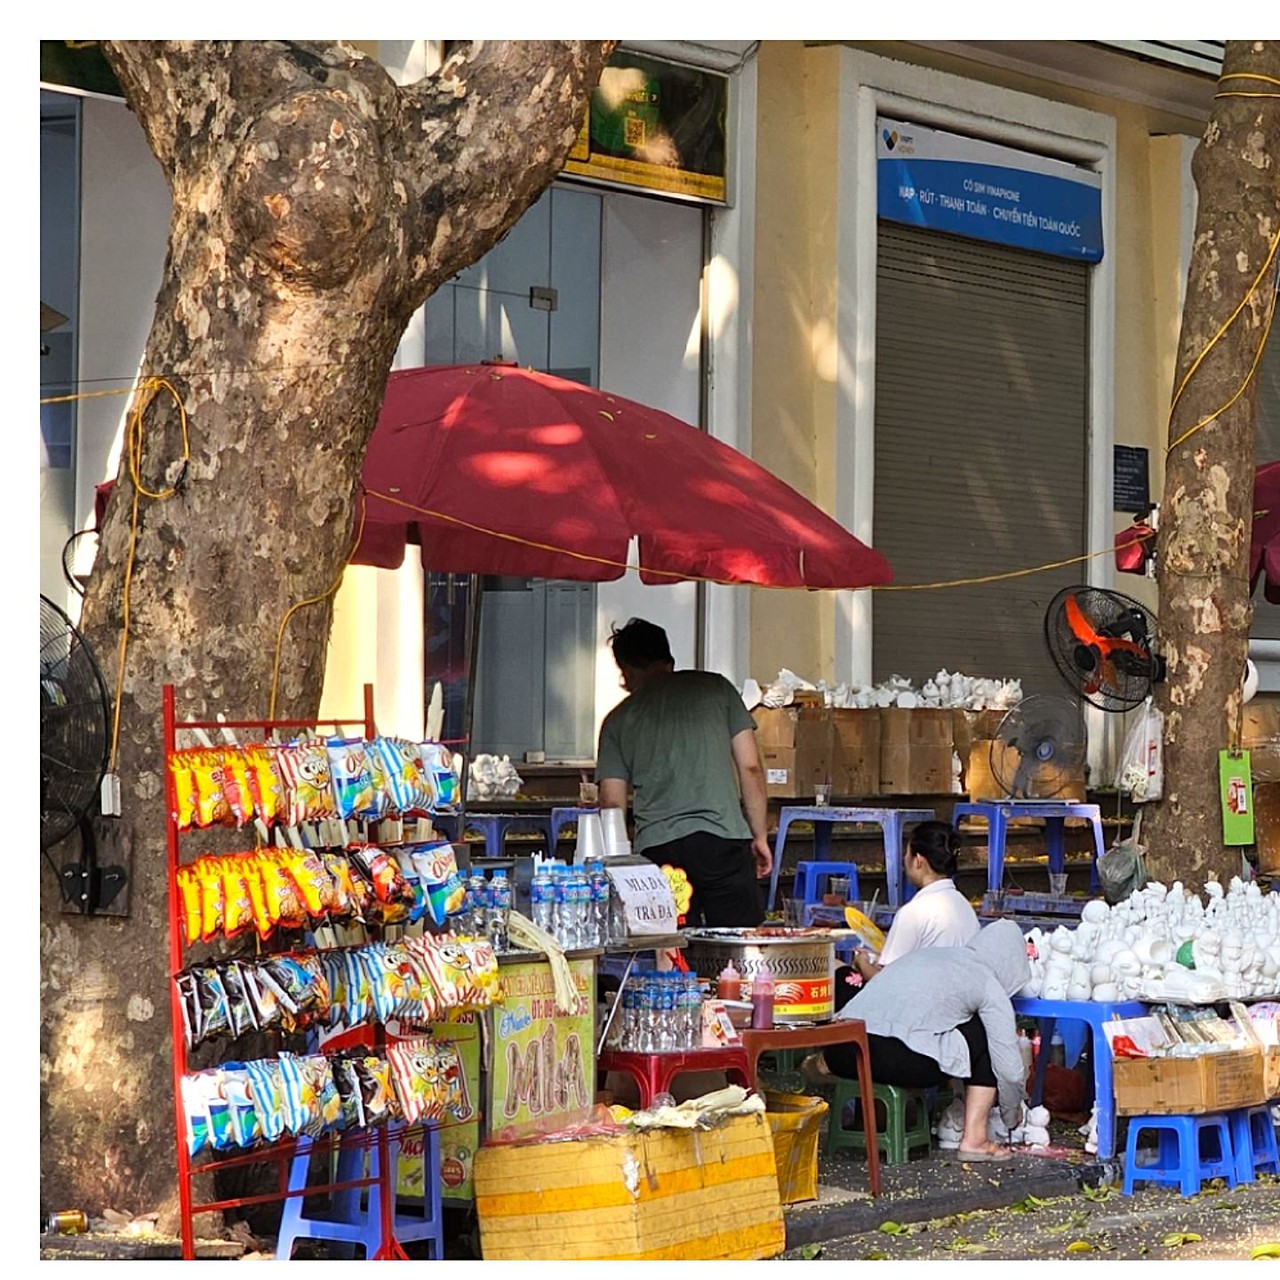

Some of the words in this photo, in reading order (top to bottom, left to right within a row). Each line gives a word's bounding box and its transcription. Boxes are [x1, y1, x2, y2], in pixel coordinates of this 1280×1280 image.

[919, 189, 934, 205] RÚT
[940, 193, 965, 212] THANH
[966, 197, 987, 216] TOÁN
[987, 183, 1020, 203] VINAPHONE
